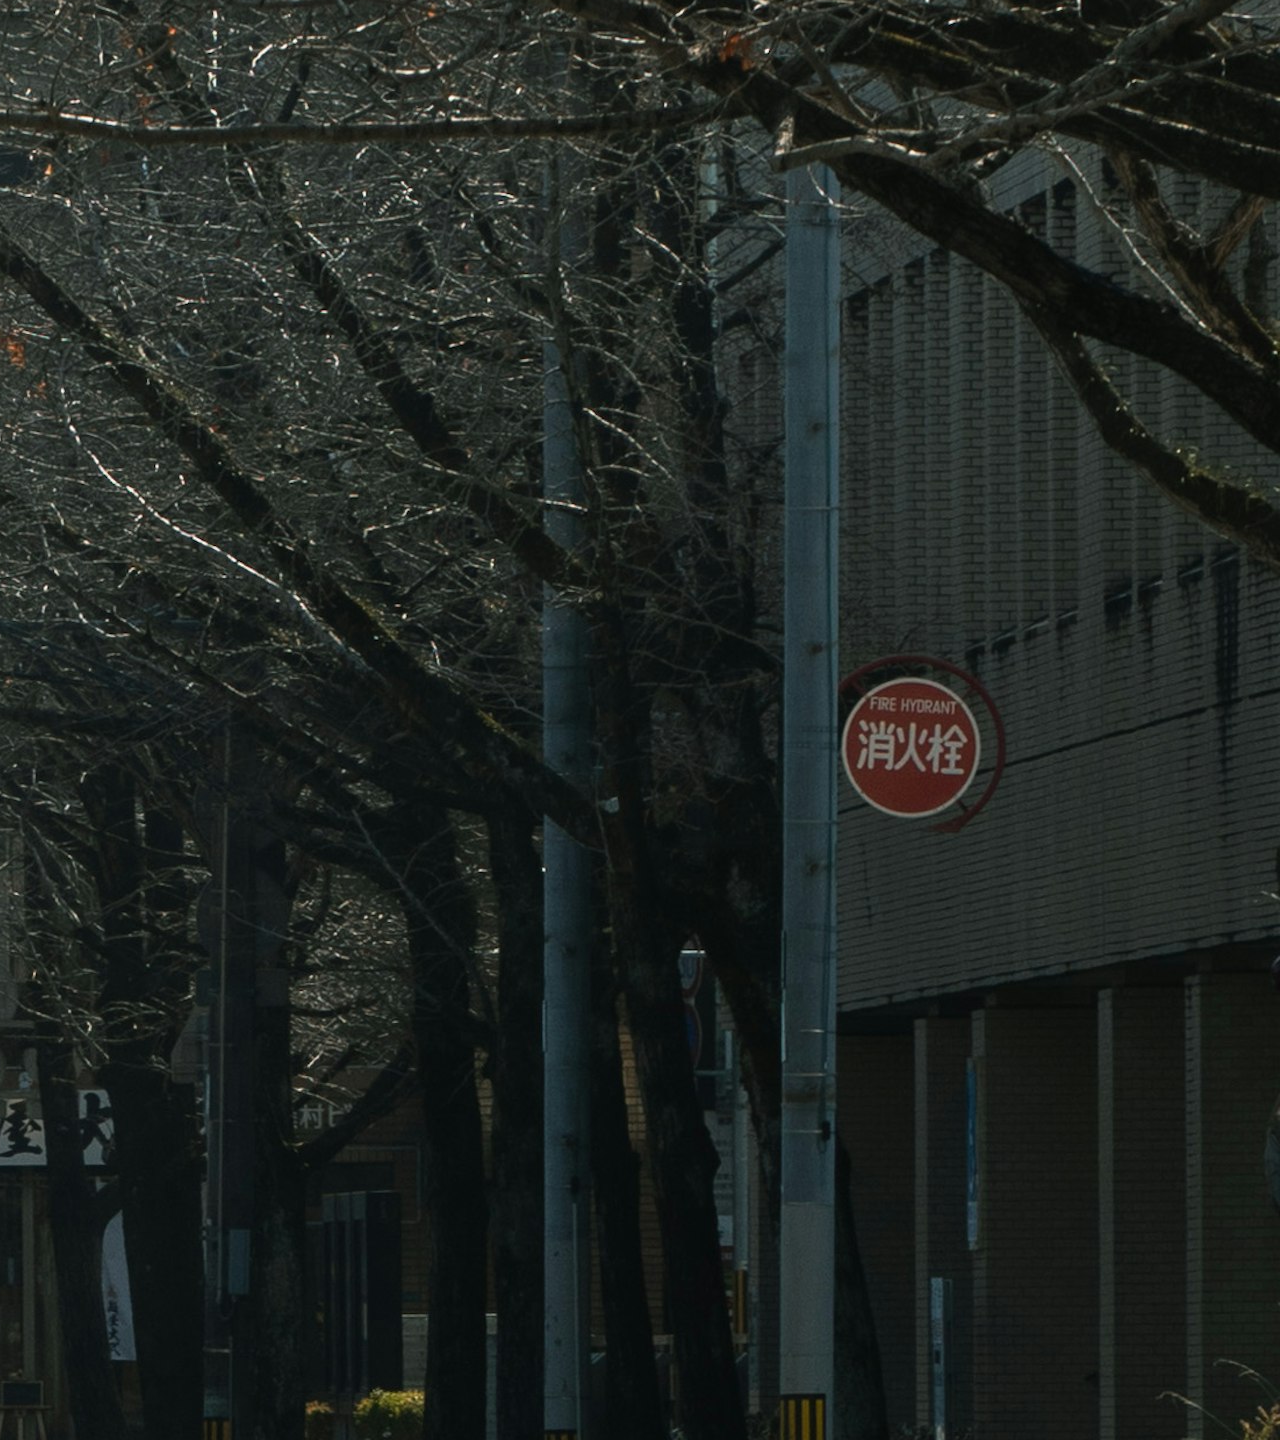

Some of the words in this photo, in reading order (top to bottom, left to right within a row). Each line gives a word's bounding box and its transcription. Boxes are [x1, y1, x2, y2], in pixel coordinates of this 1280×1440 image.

[869, 696, 897, 712] FIRE
[900, 698, 958, 715] HYDRANT
[856, 719, 969, 776] 消火栓
